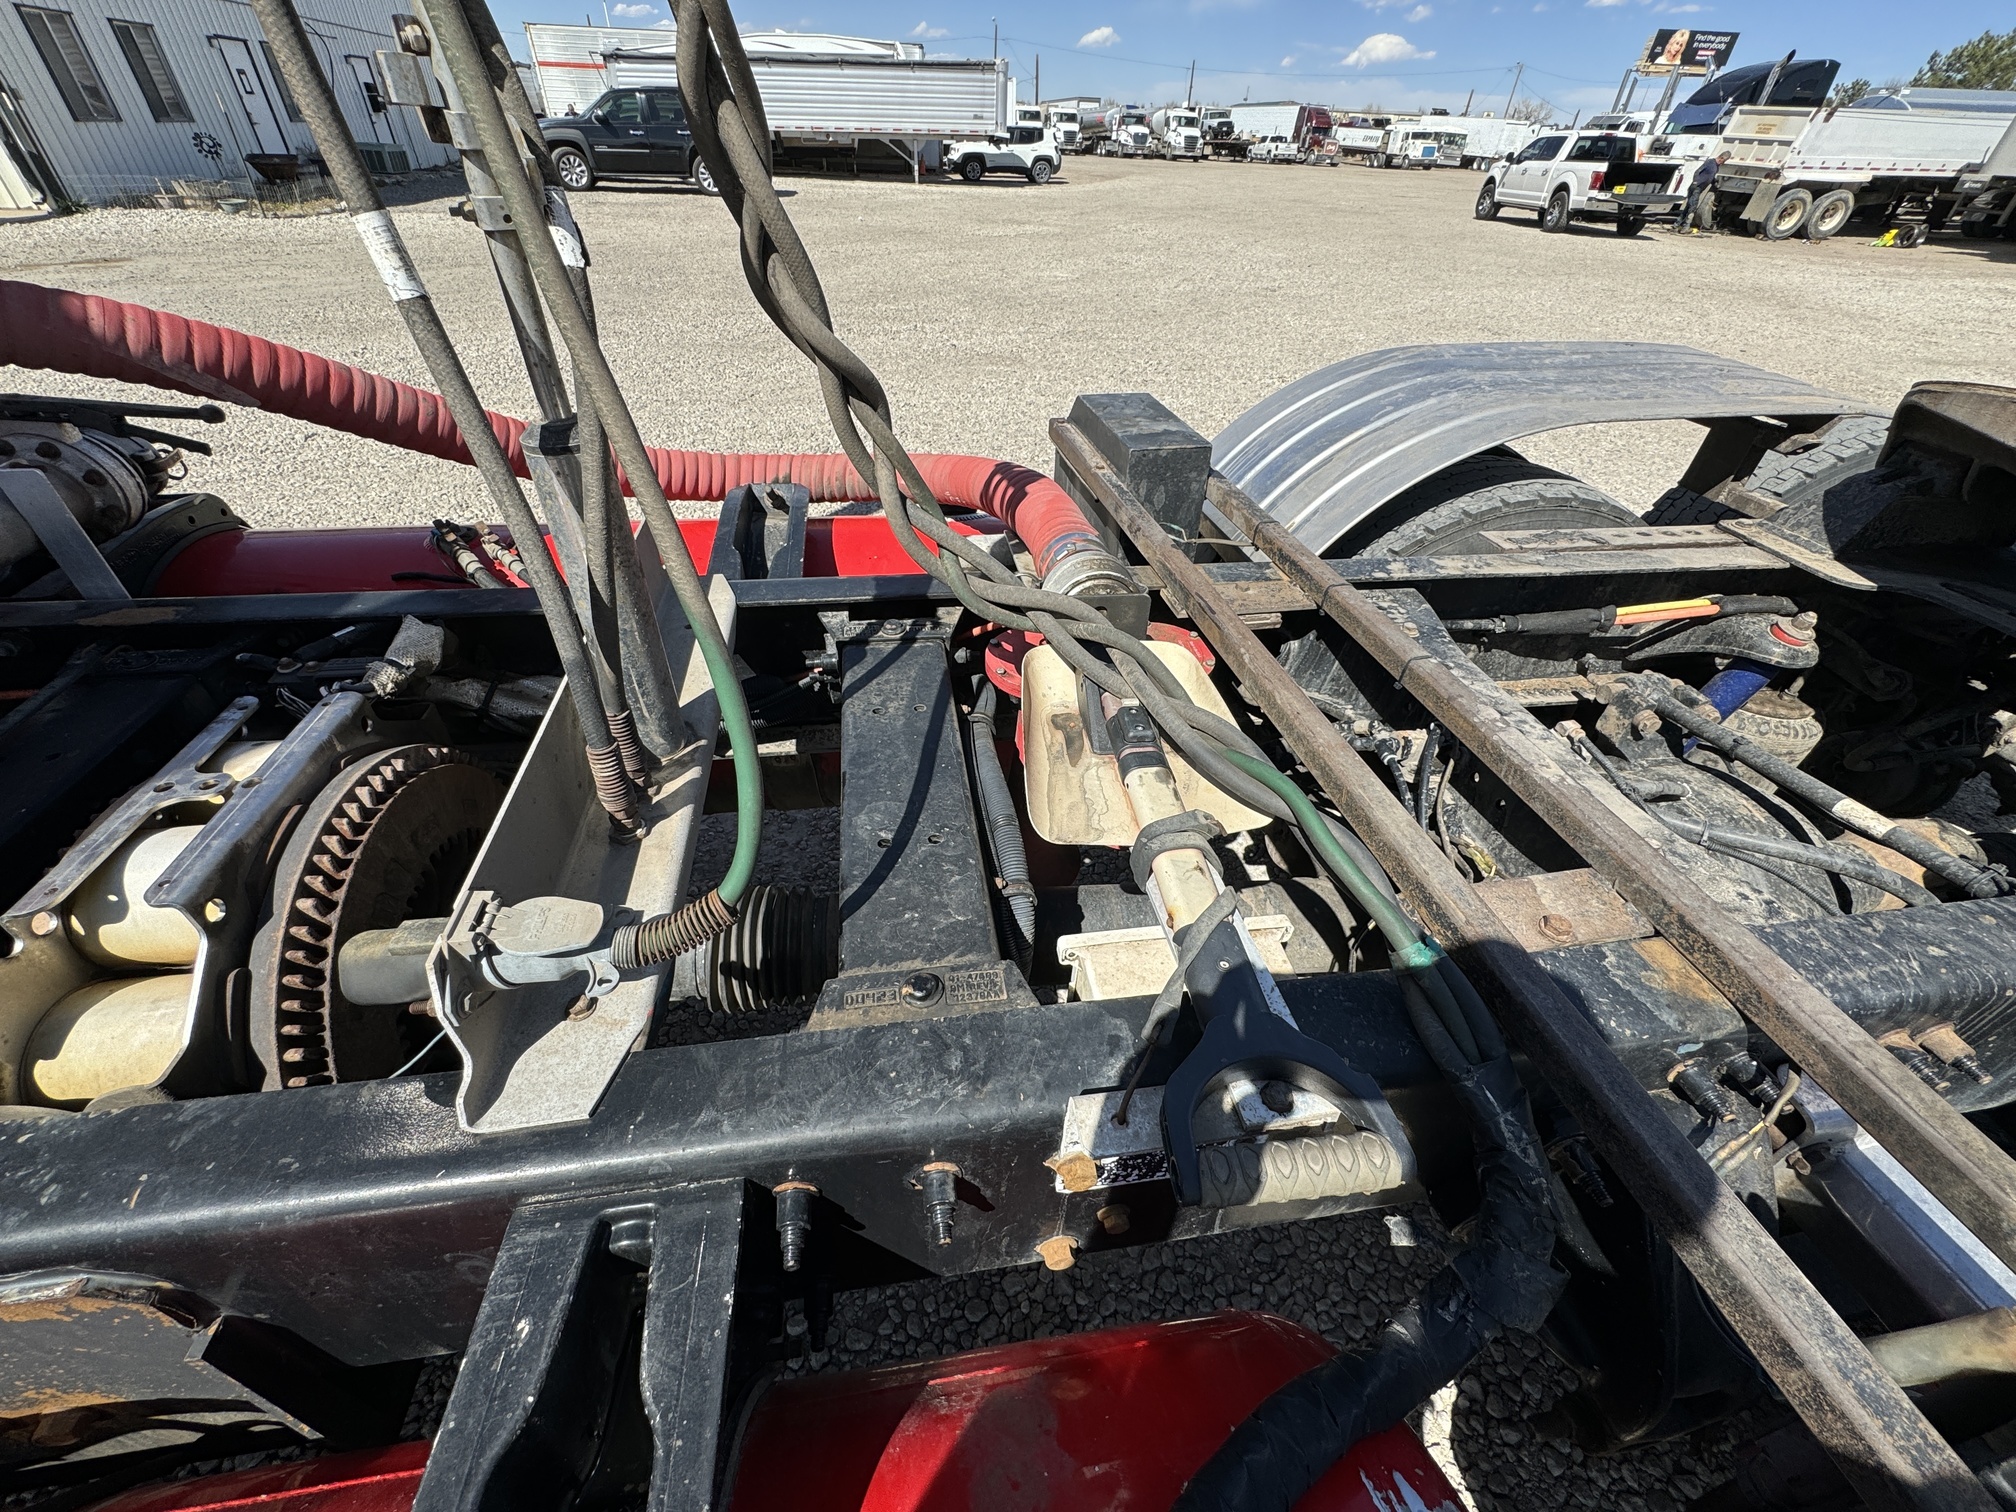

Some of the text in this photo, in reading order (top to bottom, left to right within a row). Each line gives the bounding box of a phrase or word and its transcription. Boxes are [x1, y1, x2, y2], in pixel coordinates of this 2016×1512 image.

[1694, 33, 1707, 41] Find
[1715, 35, 1731, 43] good
[1699, 42, 1727, 50] everybody
